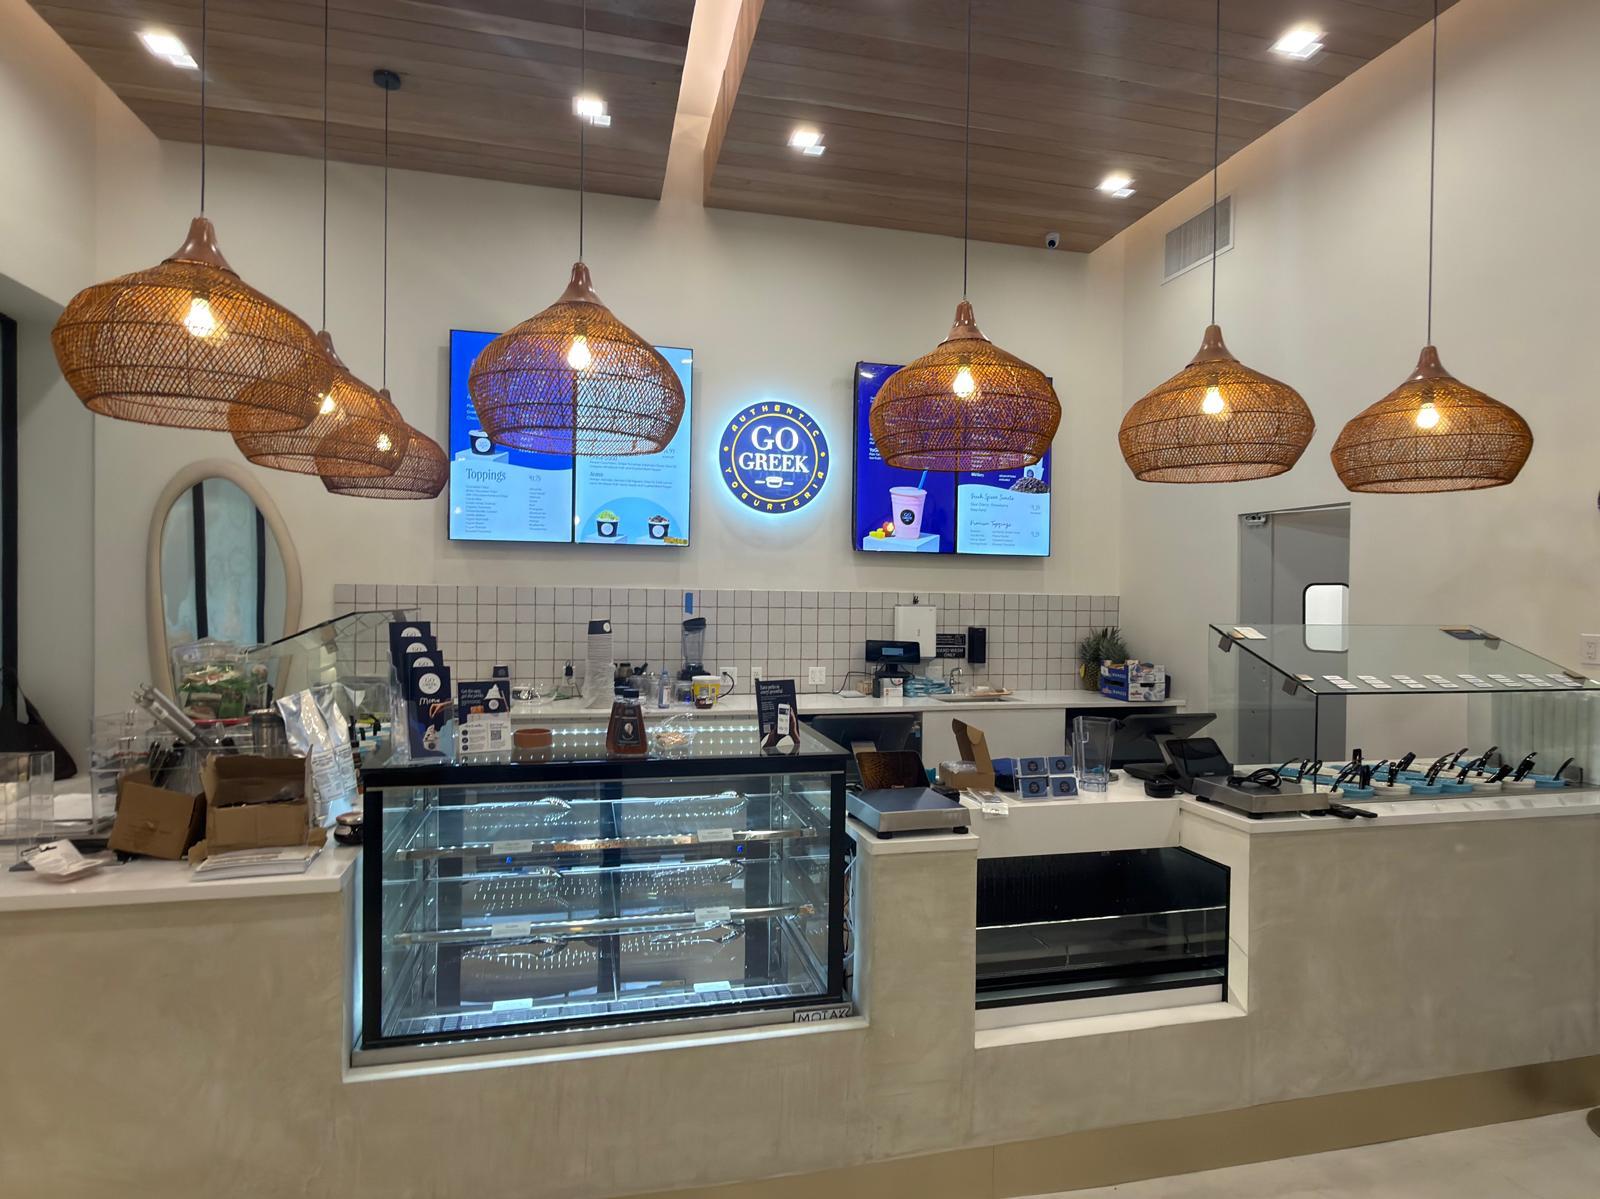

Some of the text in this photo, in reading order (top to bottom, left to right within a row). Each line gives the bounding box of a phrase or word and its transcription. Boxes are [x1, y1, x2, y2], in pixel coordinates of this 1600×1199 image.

[731, 404, 820, 438] AUTHENTIC
[751, 425, 799, 452] GO
[465, 468, 506, 483] Toppings
[738, 452, 810, 474] GREEK
[725, 467, 824, 511] YOGURTERIA
